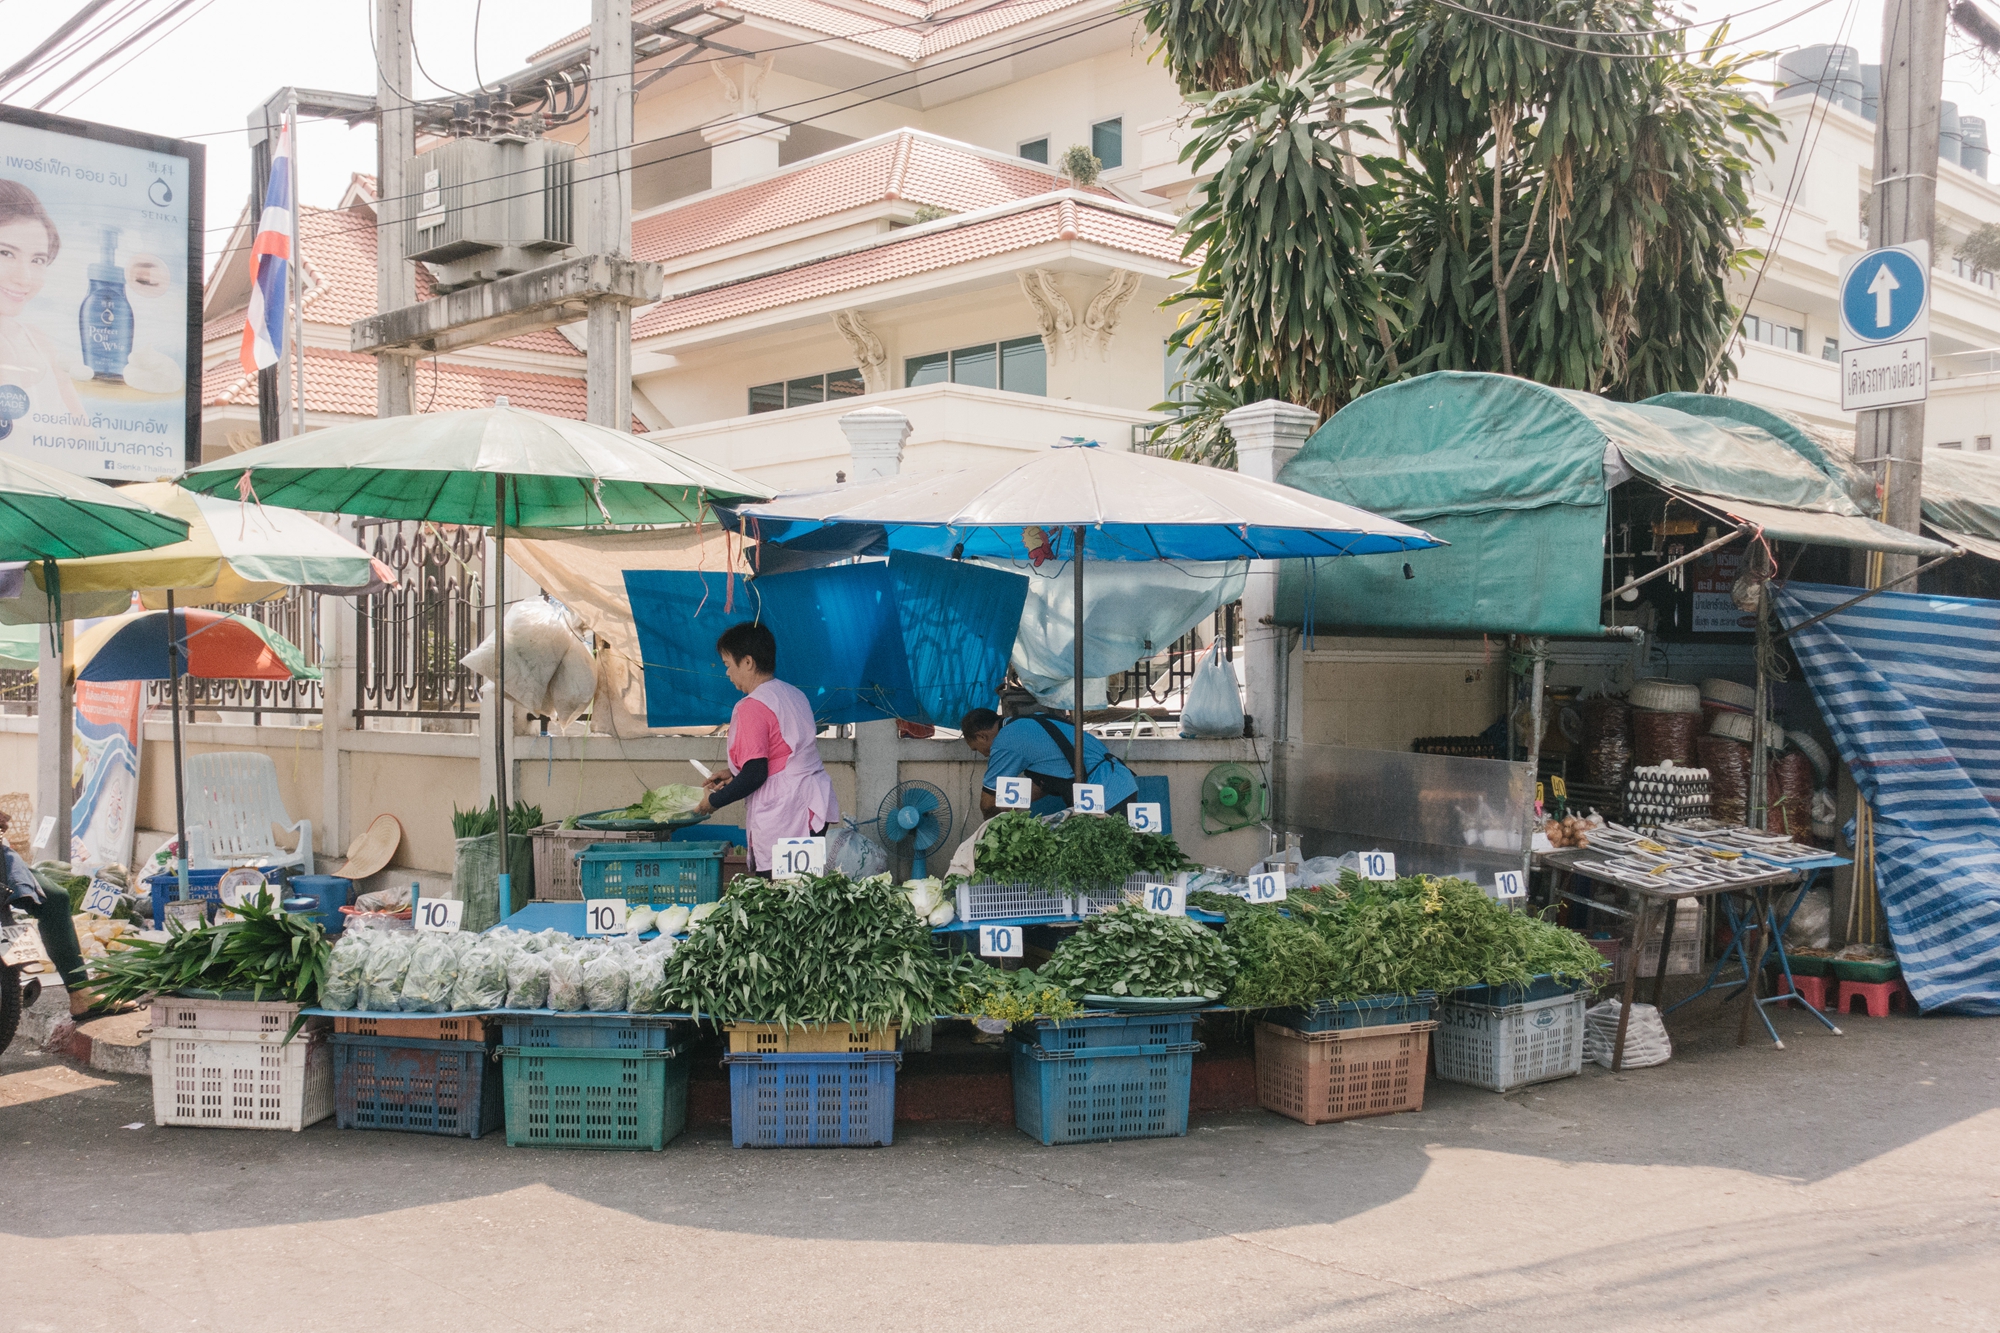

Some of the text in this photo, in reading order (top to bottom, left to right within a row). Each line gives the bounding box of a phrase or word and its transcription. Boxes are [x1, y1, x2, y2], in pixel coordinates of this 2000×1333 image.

[75, 168, 105, 184] ออย
[109, 172, 128, 188] วิป
[141, 209, 179, 224] SENKA
[88, 325, 119, 337] Perfect
[93, 333, 109, 343] Oil
[102, 341, 125, 351] Whip
[1847, 348, 1923, 397] เดินรถทางเดียว
[0, 391, 27, 402] APAN
[32, 411, 169, 435] ออยล์โฟมล้างเมคอัพ
[32, 434, 173, 458] หมดจดแม้มาสคาร่า
[116, 462, 142, 471] Senka
[143, 464, 177, 474] Thailand
[1004, 781, 1020, 805] 5
[1080, 789, 1095, 811] 5
[1134, 807, 1149, 829] 5
[782, 850, 810, 873] 10
[1363, 854, 1386, 877] 10
[1252, 875, 1276, 899] 10
[1498, 873, 1518, 894] 10
[86, 890, 114, 912] 10
[1148, 886, 1173, 911] 10
[421, 902, 448, 927] 10
[589, 906, 615, 931] 10
[986, 927, 1011, 952] 10
[1444, 1007, 1489, 1032] S.H.371
